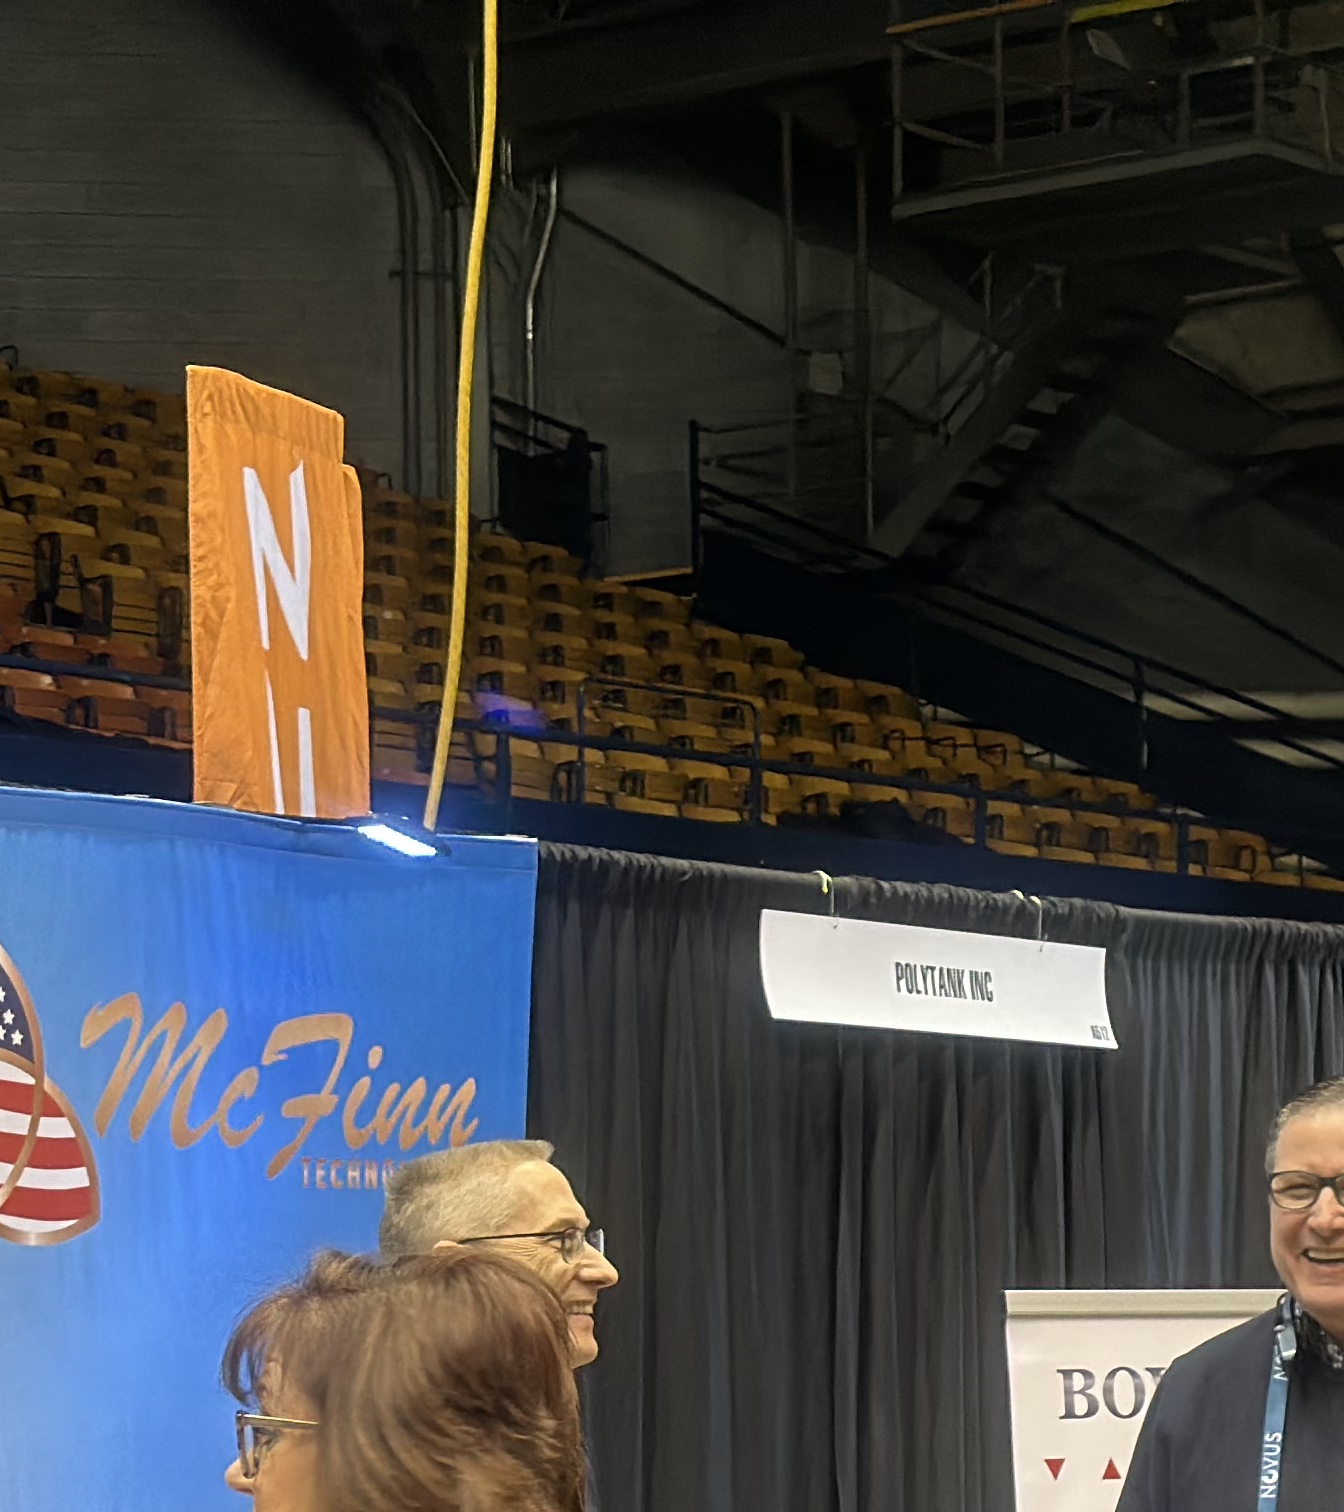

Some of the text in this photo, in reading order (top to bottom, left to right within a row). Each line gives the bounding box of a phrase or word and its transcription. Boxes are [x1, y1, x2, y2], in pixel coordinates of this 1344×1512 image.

[895, 961, 994, 1002] POLYTANK INC
[80, 992, 478, 1179] McFinn
[1259, 1432, 1283, 1498] NOVUS
